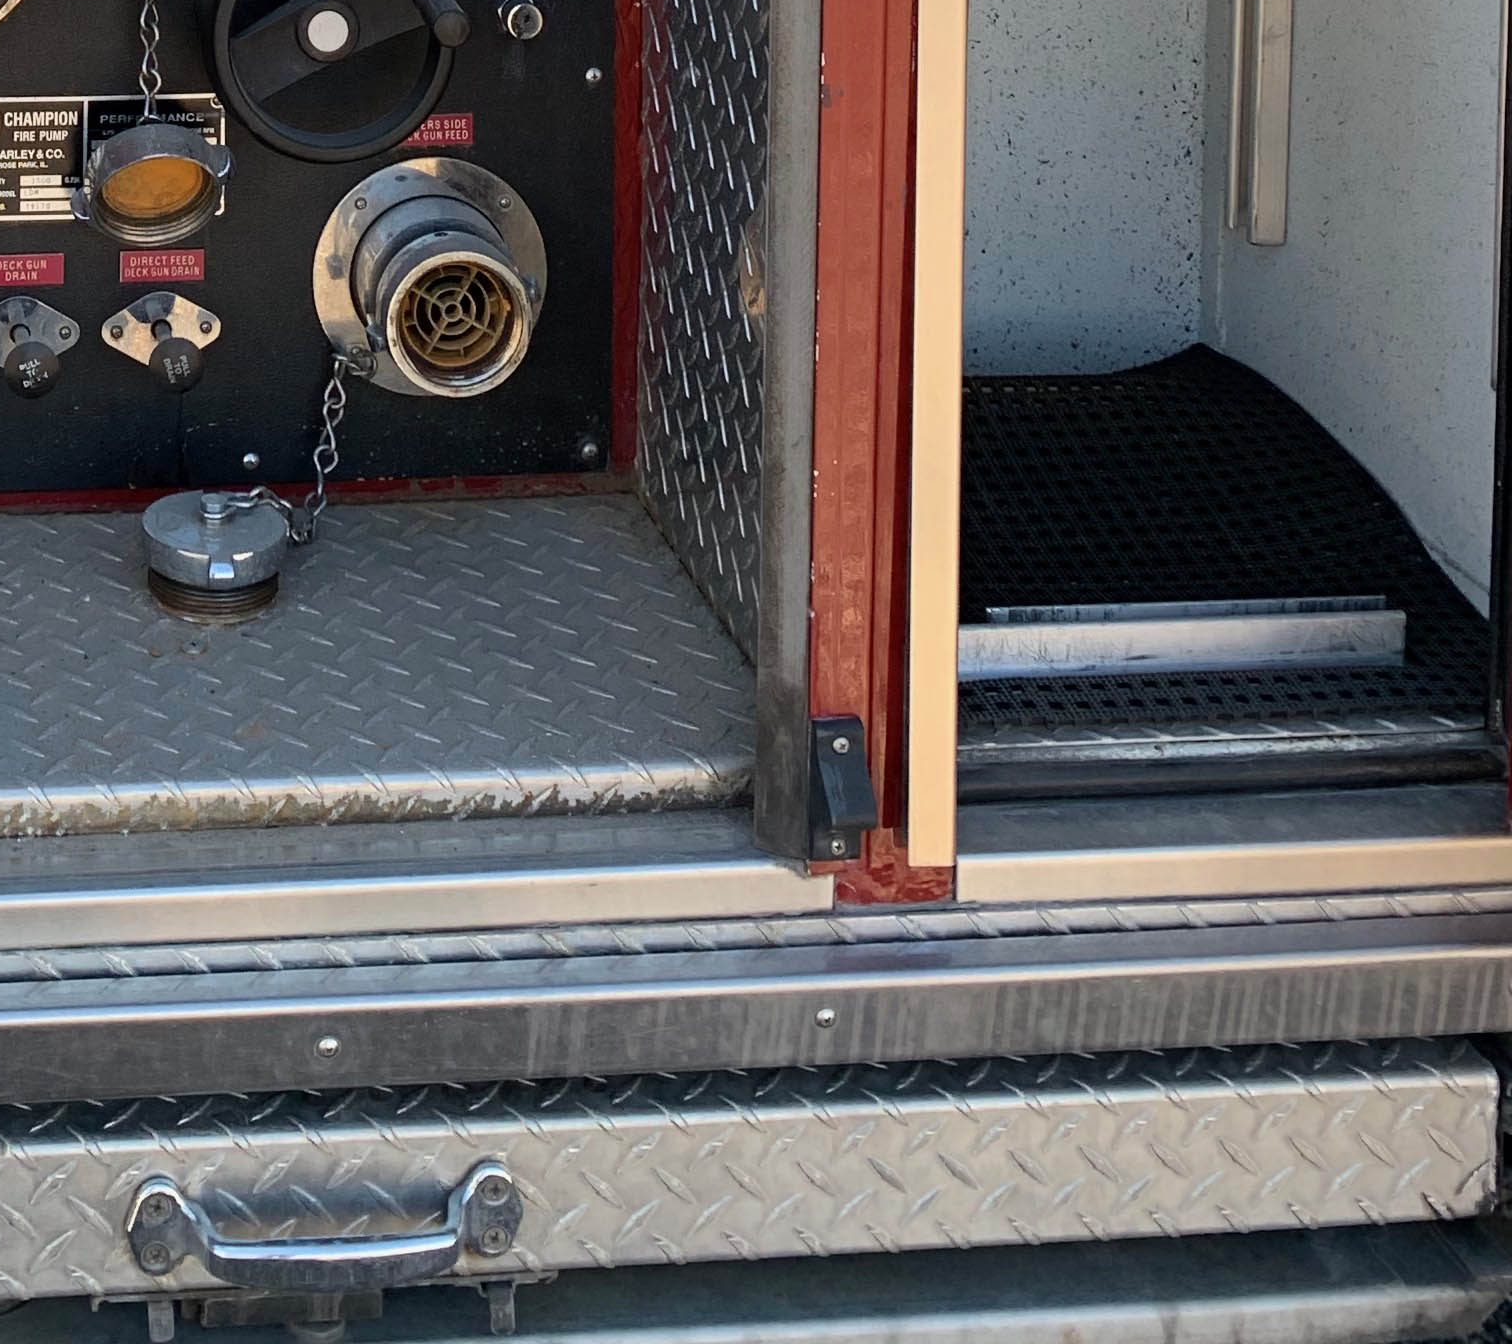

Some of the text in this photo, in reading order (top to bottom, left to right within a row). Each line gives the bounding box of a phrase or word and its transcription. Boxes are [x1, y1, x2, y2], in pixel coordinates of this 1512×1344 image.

[3, 110, 79, 127] CHAMPION
[443, 118, 468, 130] SIDE
[13, 130, 69, 143] FIRE PUMP
[422, 130, 443, 142] GUN
[444, 130, 469, 141] FEED
[35, 149, 45, 160] &
[45, 148, 66, 160] CO.
[25, 259, 48, 271] GUN
[129, 255, 196, 267] DIRECT FEED
[4, 270, 39, 282] DRAIN
[124, 266, 201, 279] DECK GUN DRAIN
